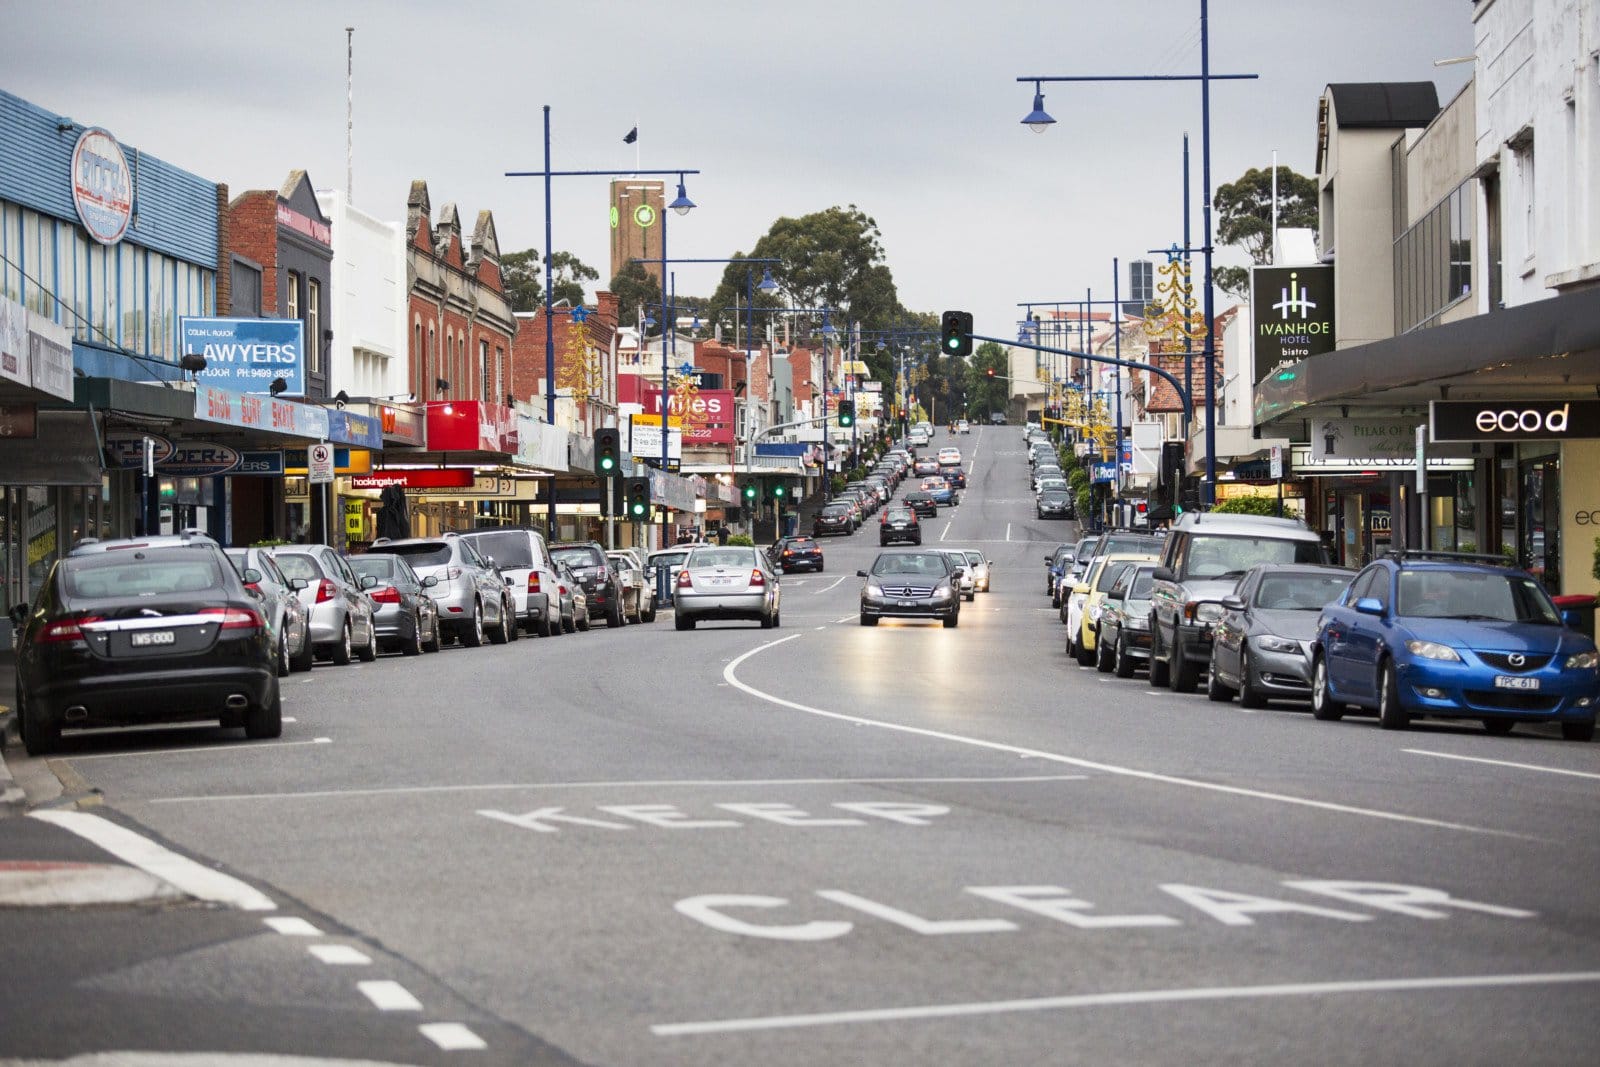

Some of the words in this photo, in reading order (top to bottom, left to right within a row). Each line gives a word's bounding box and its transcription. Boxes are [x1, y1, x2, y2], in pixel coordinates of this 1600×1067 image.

[1260, 322, 1329, 335] IVANHOE
[1280, 335, 1311, 344] HOTEL
[1282, 347, 1309, 356] bistro
[655, 394, 722, 413] Miles
[353, 476, 408, 489] hockingstuart
[345, 504, 361, 514] SALE
[350, 518, 360, 528] ON
[475, 802, 951, 833] KEEP
[674, 879, 1536, 941] CLEAR
